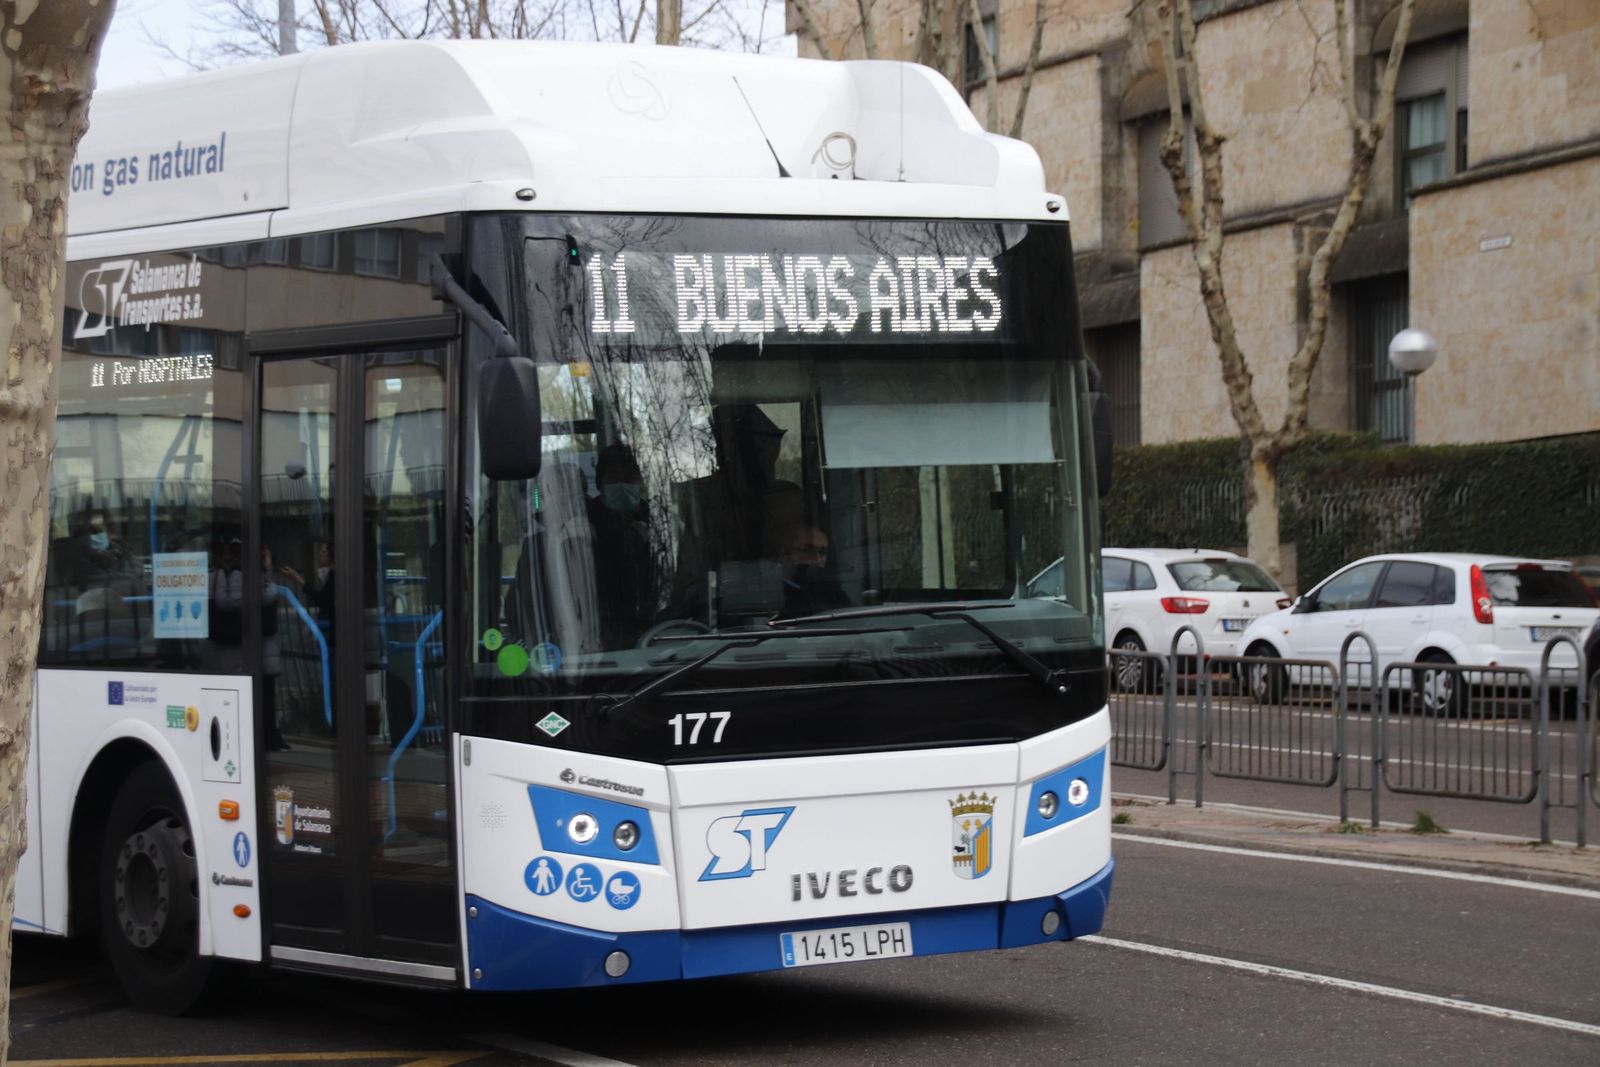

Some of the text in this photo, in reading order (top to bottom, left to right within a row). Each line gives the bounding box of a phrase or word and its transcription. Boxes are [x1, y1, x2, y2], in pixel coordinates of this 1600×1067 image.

[102, 155, 139, 196] gas
[147, 131, 226, 182] natural
[130, 252, 203, 295] Salamanca de
[587, 253, 1002, 334] 11 BUENOS AIRES
[119, 292, 182, 333] Transportes
[90, 353, 214, 387] 11 Por HOSPITALES
[541, 718, 564, 731] GNC
[668, 711, 732, 746] 177
[578, 775, 646, 798] Castrosua
[790, 864, 915, 902] IVECO
[801, 928, 906, 961] 1415 LPH
